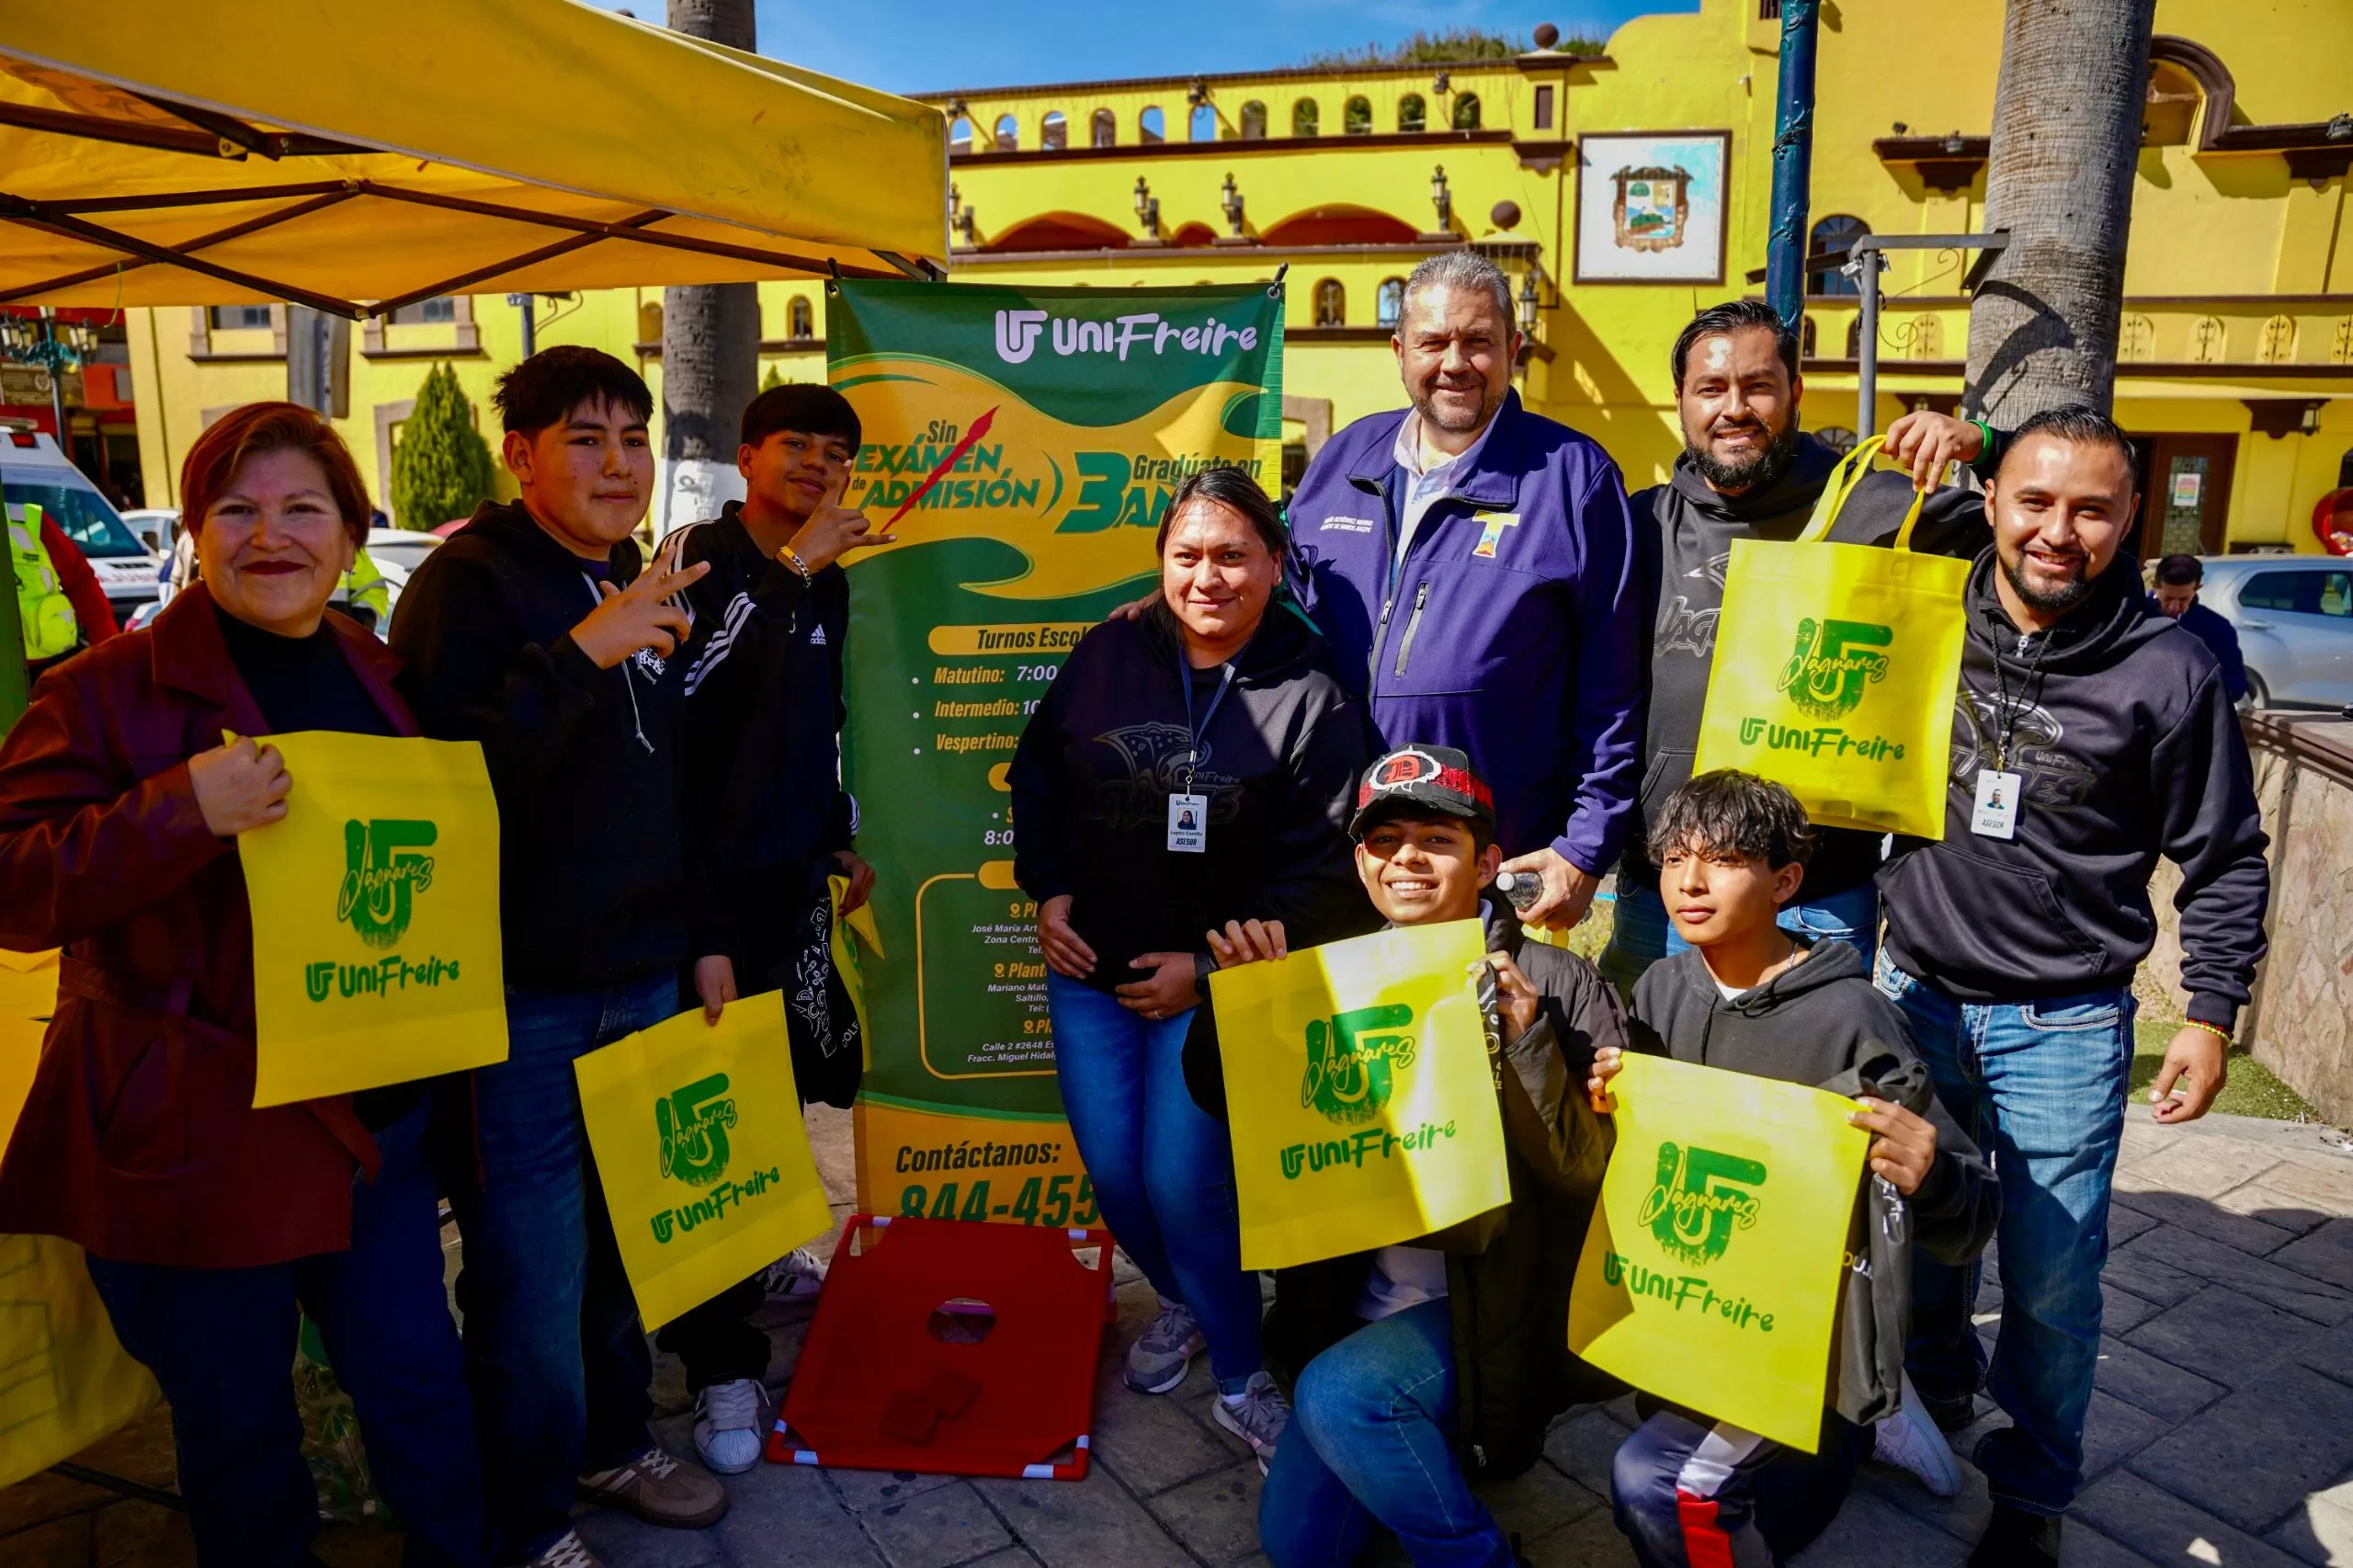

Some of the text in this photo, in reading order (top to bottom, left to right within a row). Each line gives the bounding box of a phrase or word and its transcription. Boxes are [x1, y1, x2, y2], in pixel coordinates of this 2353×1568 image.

[926, 420, 958, 443] Sin
[855, 433, 1004, 474] EXÁMEN
[852, 468, 1040, 511] de ADMISIÓN
[1054, 451, 1131, 533] 3
[977, 629, 1035, 649] Turnos
[934, 665, 1058, 684] Matutino: 7:00
[935, 699, 1019, 717] Intermedio:
[937, 733, 1019, 755] Vespertino:
[972, 923, 993, 933] José
[995, 924, 1020, 933] María
[984, 935, 1007, 944] Zona
[1008, 961, 1047, 978] Plant
[987, 983, 1026, 993] Mariano
[1029, 1005, 1044, 1013] Tel:
[983, 1042, 1006, 1051] Calle
[1015, 1041, 1043, 1050] #2648
[967, 1051, 1056, 1062] Fracc. Miguel Hidal
[895, 1140, 1062, 1173] Contáctanos:
